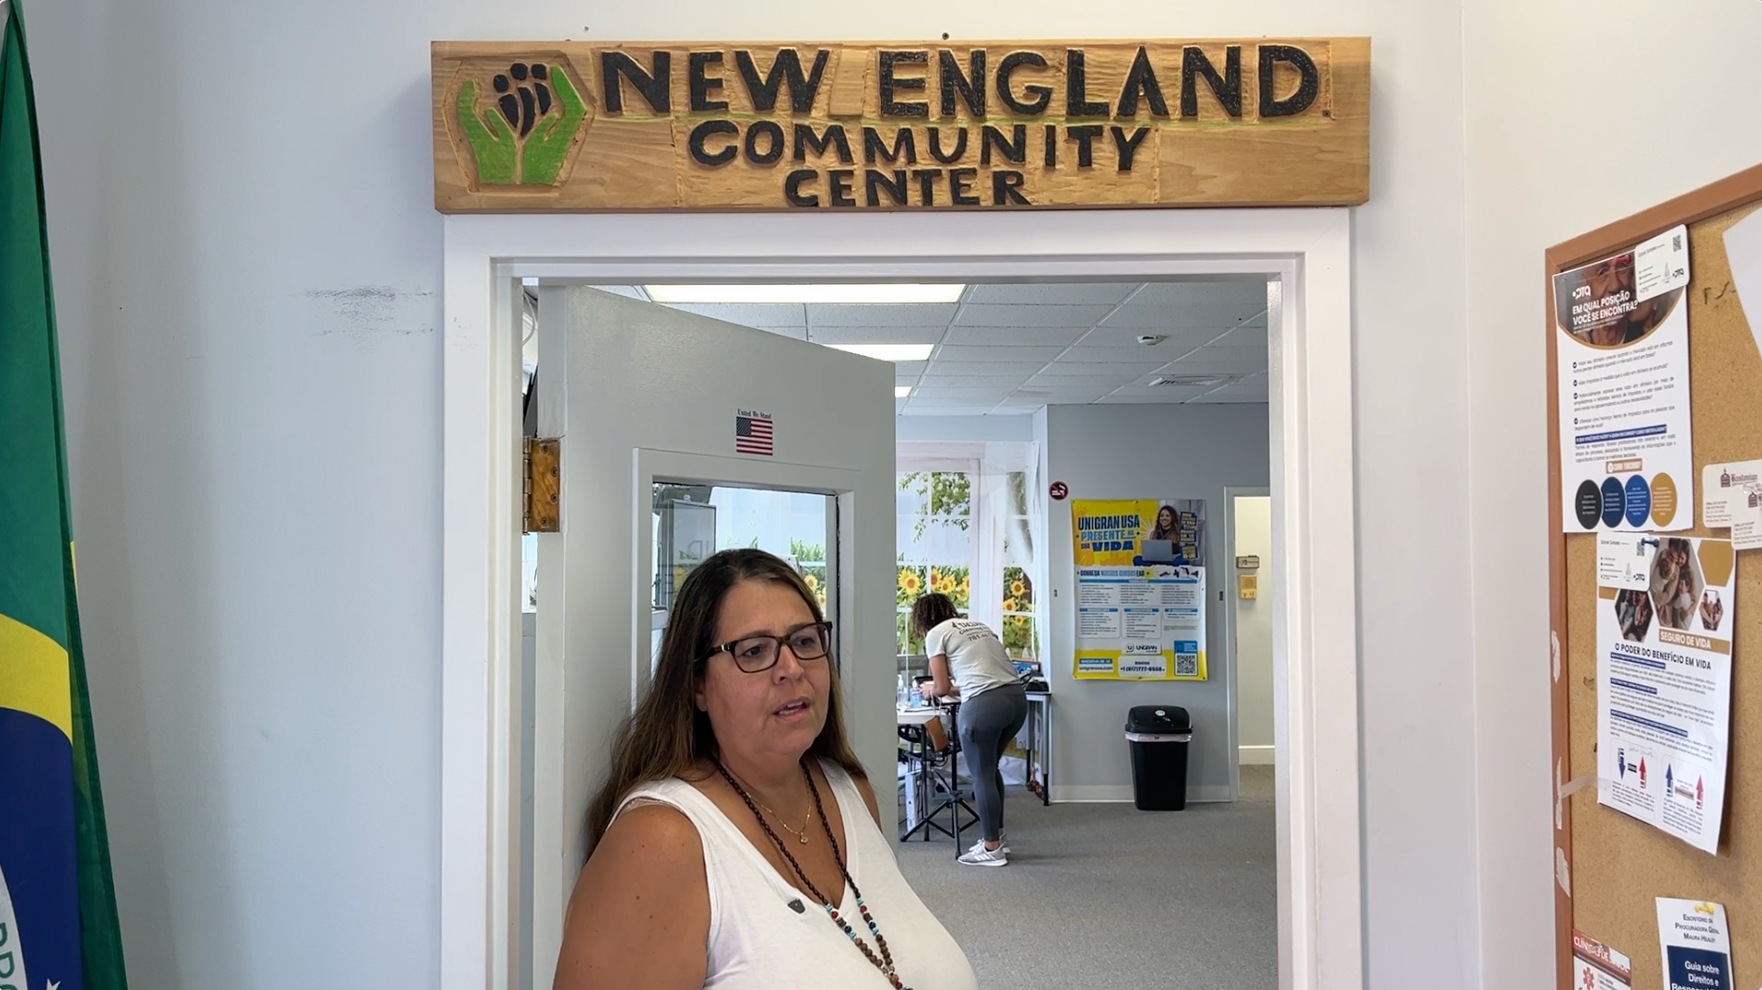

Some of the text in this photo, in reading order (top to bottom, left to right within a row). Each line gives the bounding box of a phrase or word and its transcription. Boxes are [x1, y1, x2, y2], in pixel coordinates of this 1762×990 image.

[602, 44, 1319, 118] NEW ENGLAND
[689, 119, 1152, 172] COMMUNITY
[785, 167, 1031, 208] CENTER
[1573, 290, 1630, 315] EM QUAL POSIÇÃO
[1573, 311, 1591, 325] VOCÊ
[1591, 311, 1600, 322] SE
[1600, 301, 1638, 319] ENCONTRA?
[1078, 514, 1140, 531] UNIGRAN USA
[1081, 530, 1126, 542] PRESENTE
[1092, 540, 1134, 552] VIDA
[1660, 630, 1711, 649] SEGURO DE VIDA
[1615, 642, 1621, 651] O
[1621, 643, 1641, 655] PODER
[1642, 648, 1652, 658] DO
[1652, 651, 1685, 664] BENEFÍCIO
[1685, 659, 1695, 667] EM
[1696, 661, 1712, 671] VIDA
[1684, 960, 1720, 975] Guia sobre
[1688, 973, 1720, 987] Direitos e
